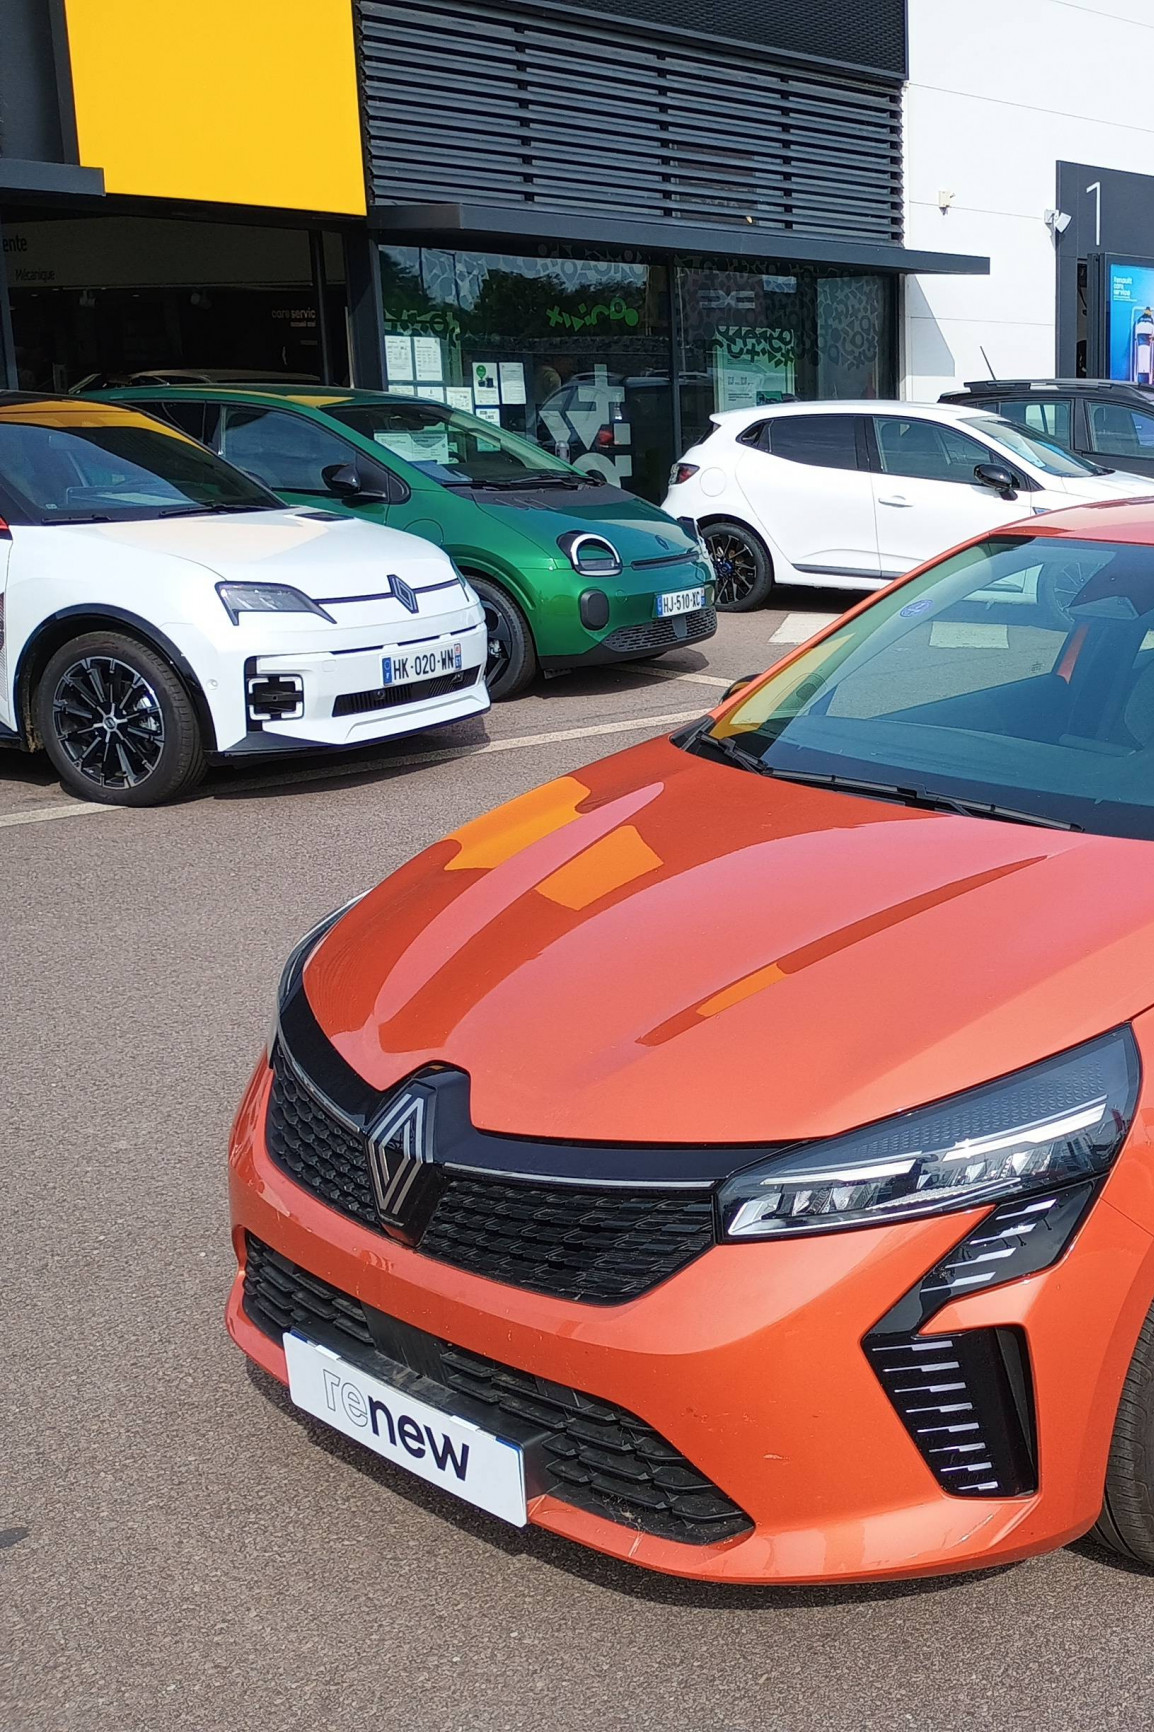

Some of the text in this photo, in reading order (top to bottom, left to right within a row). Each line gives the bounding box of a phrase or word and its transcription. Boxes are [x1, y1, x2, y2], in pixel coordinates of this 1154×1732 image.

[1086, 181, 1101, 246] 1
[2, 235, 28, 252] ente
[290, 306, 316, 319] servic
[393, 648, 455, 681] HK-020-WN
[323, 1369, 469, 1482] renew
